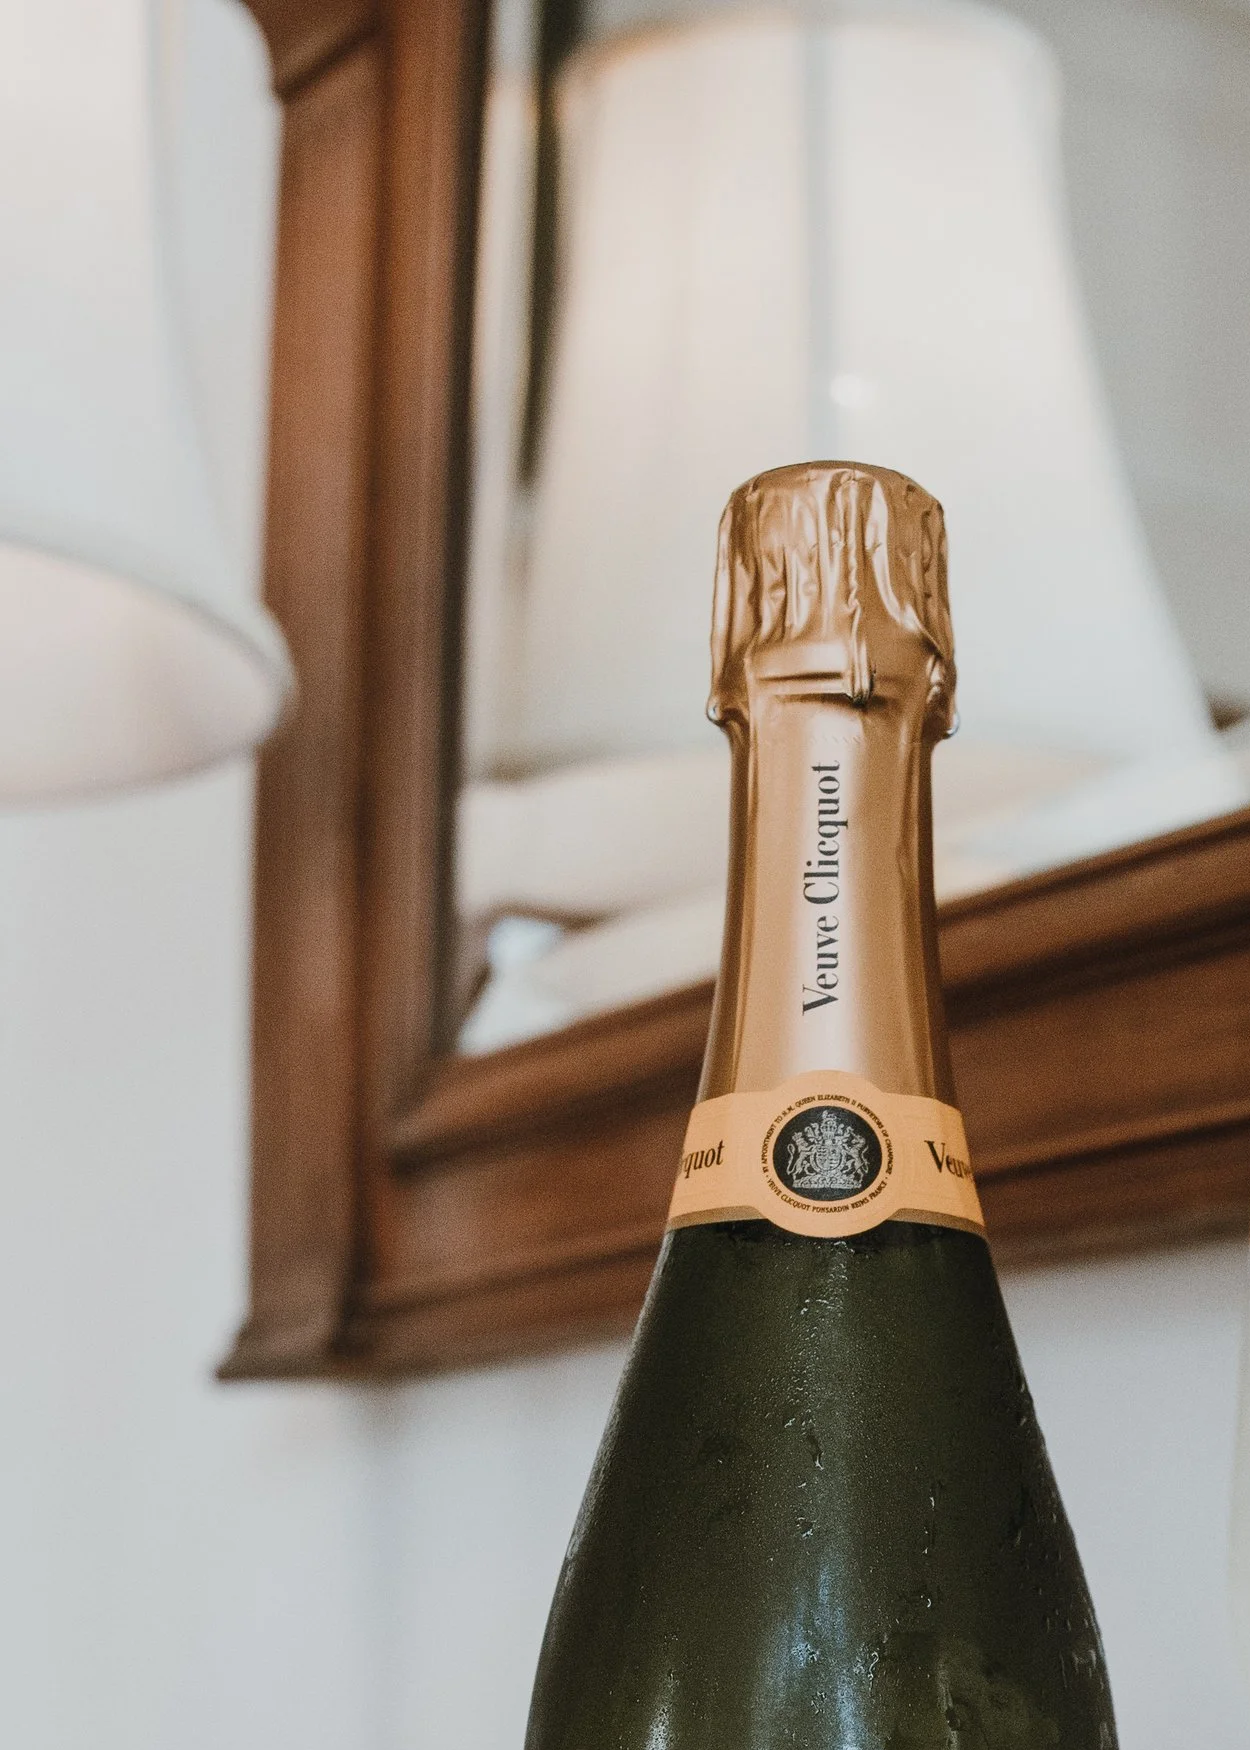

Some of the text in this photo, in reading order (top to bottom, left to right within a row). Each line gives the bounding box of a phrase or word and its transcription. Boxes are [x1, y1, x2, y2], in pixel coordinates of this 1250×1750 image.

[802, 760, 848, 1016] Veuve Clicquot
[682, 1140, 725, 1179] quot
[781, 1194, 811, 1211] CLICQUOT
